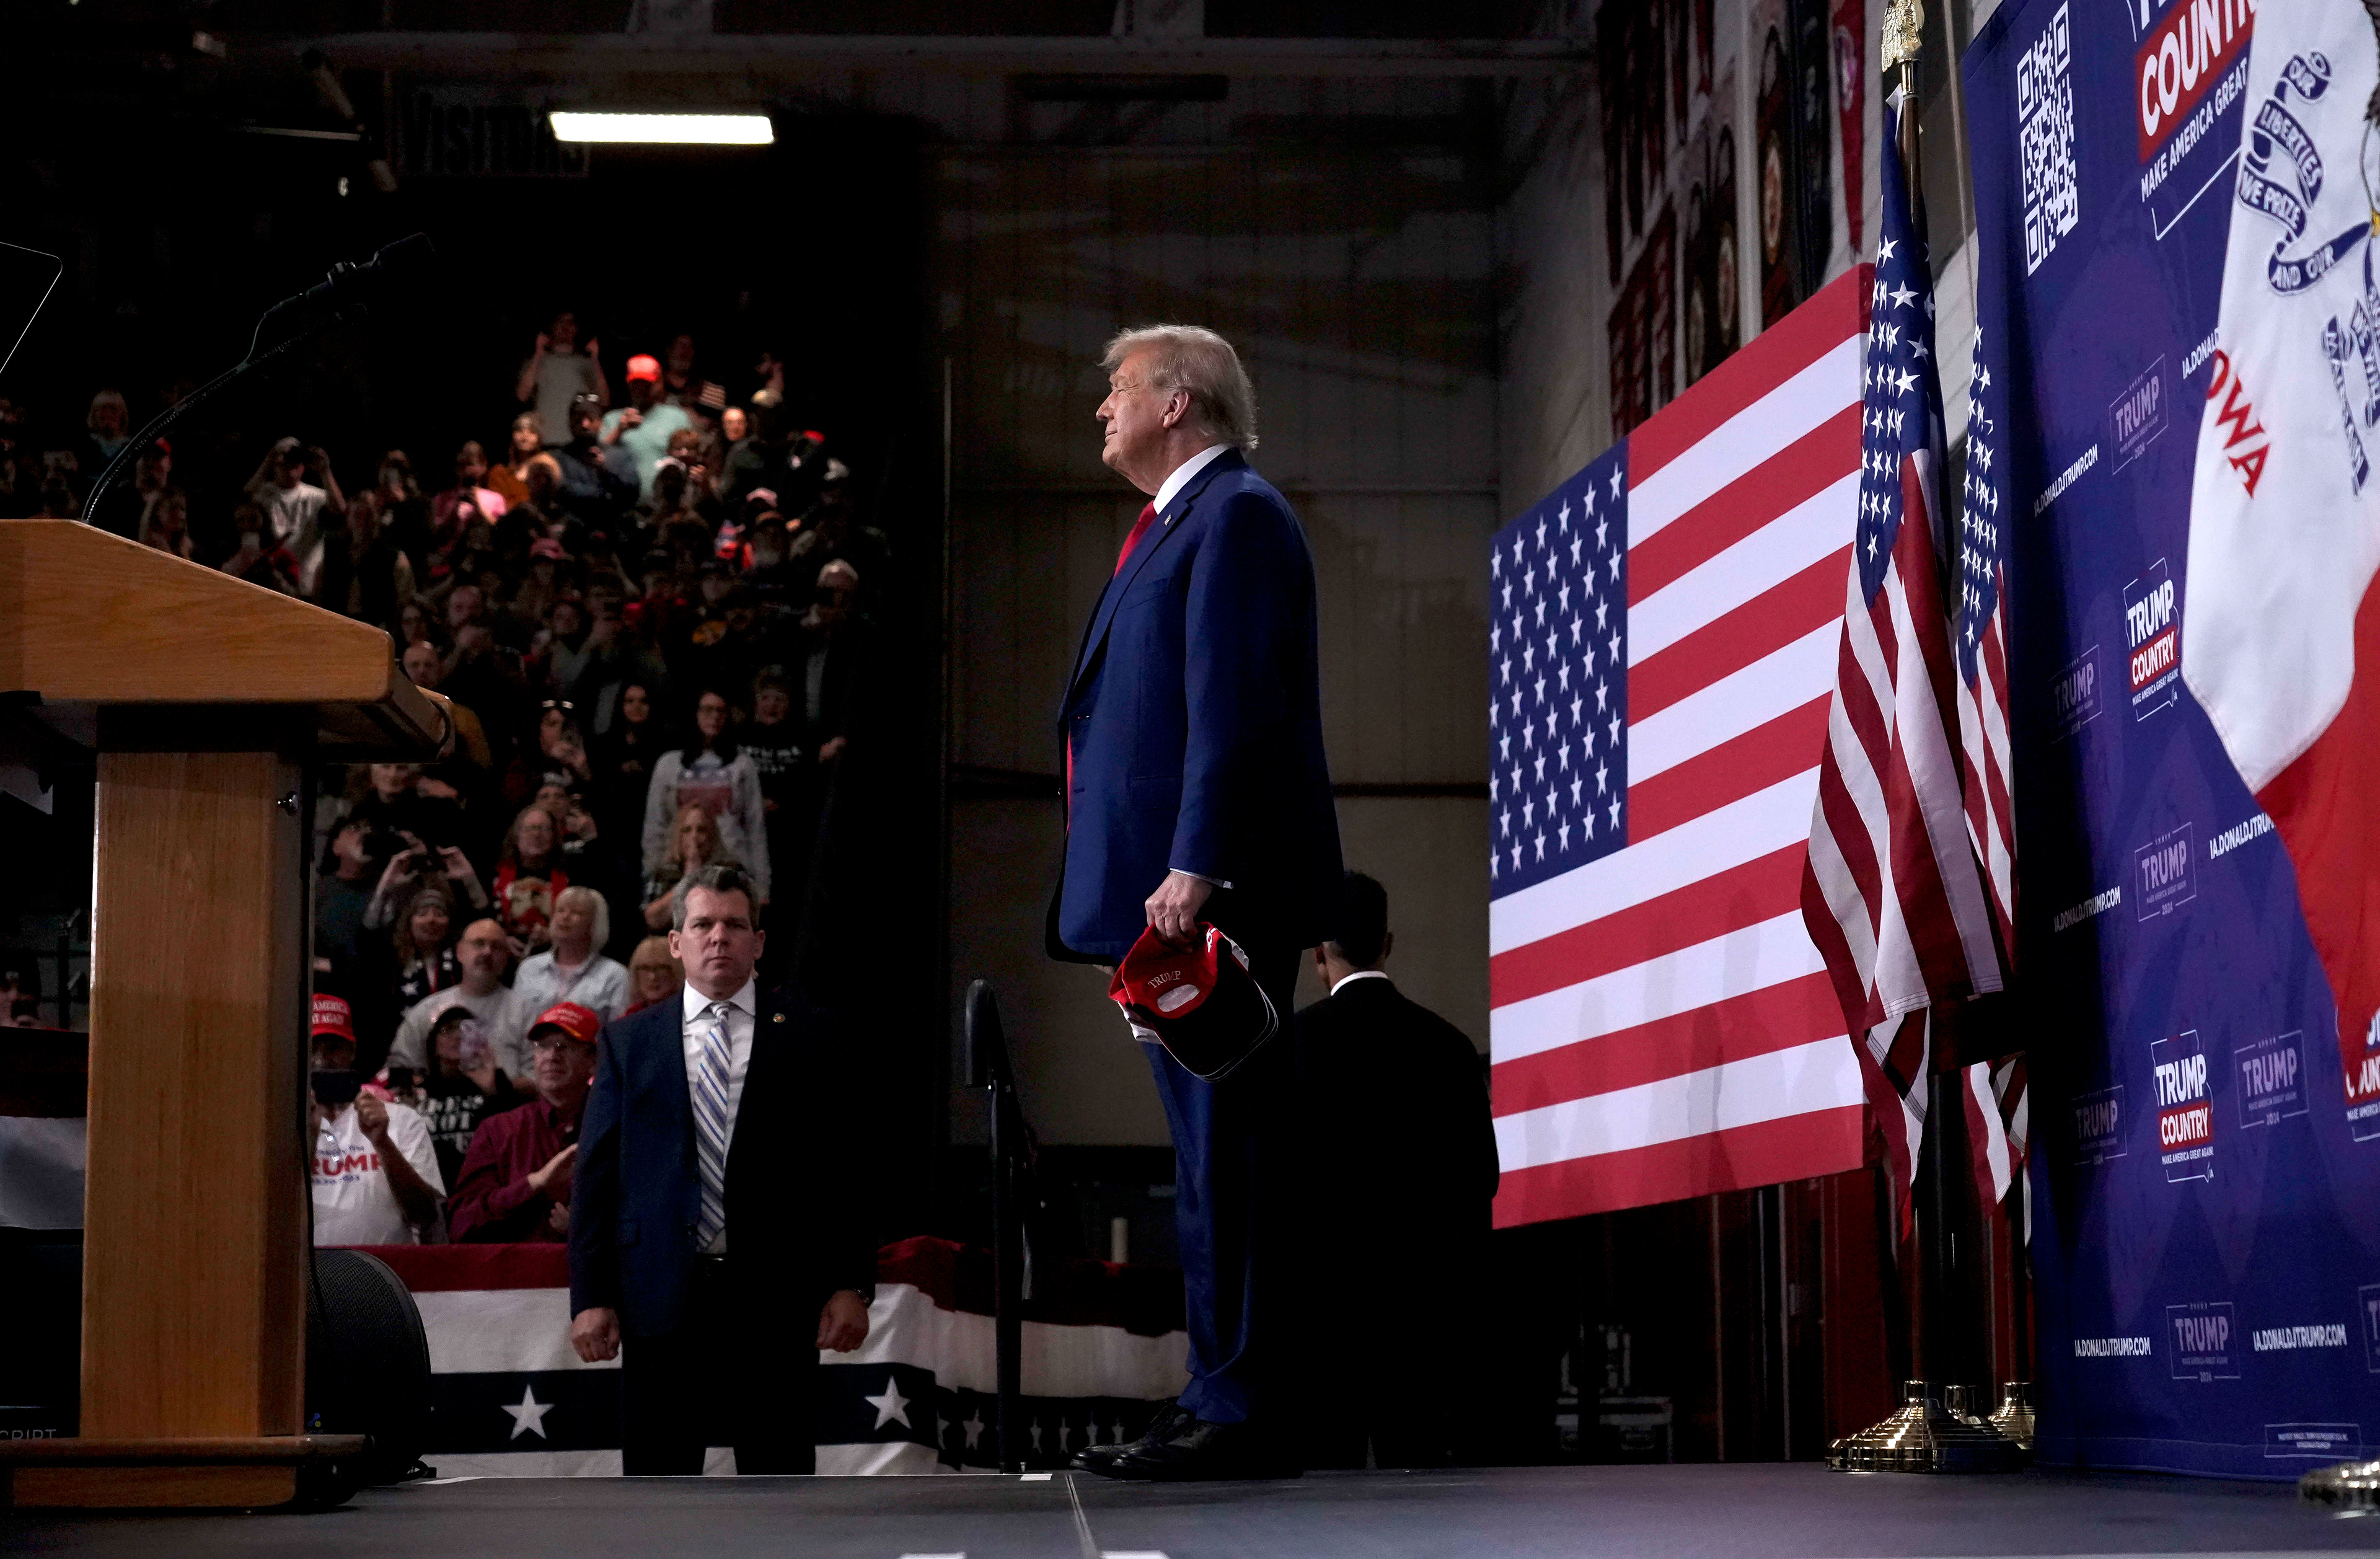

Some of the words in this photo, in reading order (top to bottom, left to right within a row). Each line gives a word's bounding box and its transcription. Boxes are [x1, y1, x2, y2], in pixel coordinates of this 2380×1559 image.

[2141, 152, 2168, 203] MAKE
[2169, 100, 2215, 172] AMERICA
[2215, 56, 2248, 117] GREAT
[2260, 104, 2322, 188] LIBERTIES
[2240, 170, 2263, 205] WE
[2270, 264, 2301, 289] AND
[2115, 376, 2159, 442] TRUMP
[2034, 443, 2098, 518] IA.DONALDJTRUMP.COM
[2127, 579, 2174, 647] TRUMP
[2131, 631, 2175, 686] COUNTRY
[2054, 662, 2094, 715] TRUMP
[2141, 840, 2187, 891] TRUMP
[1148, 970, 1181, 989] TRUMP
[2156, 1053, 2206, 1106] TRUMP
[2242, 1048, 2298, 1097] TRUMP
[2075, 1099, 2118, 1139] TRUMP
[2161, 1107, 2208, 1145] COUNTRY
[2074, 1337, 2151, 1357] IA.DONALDJTRUMP.COM
[2175, 1315, 2229, 1352] TRUMP
